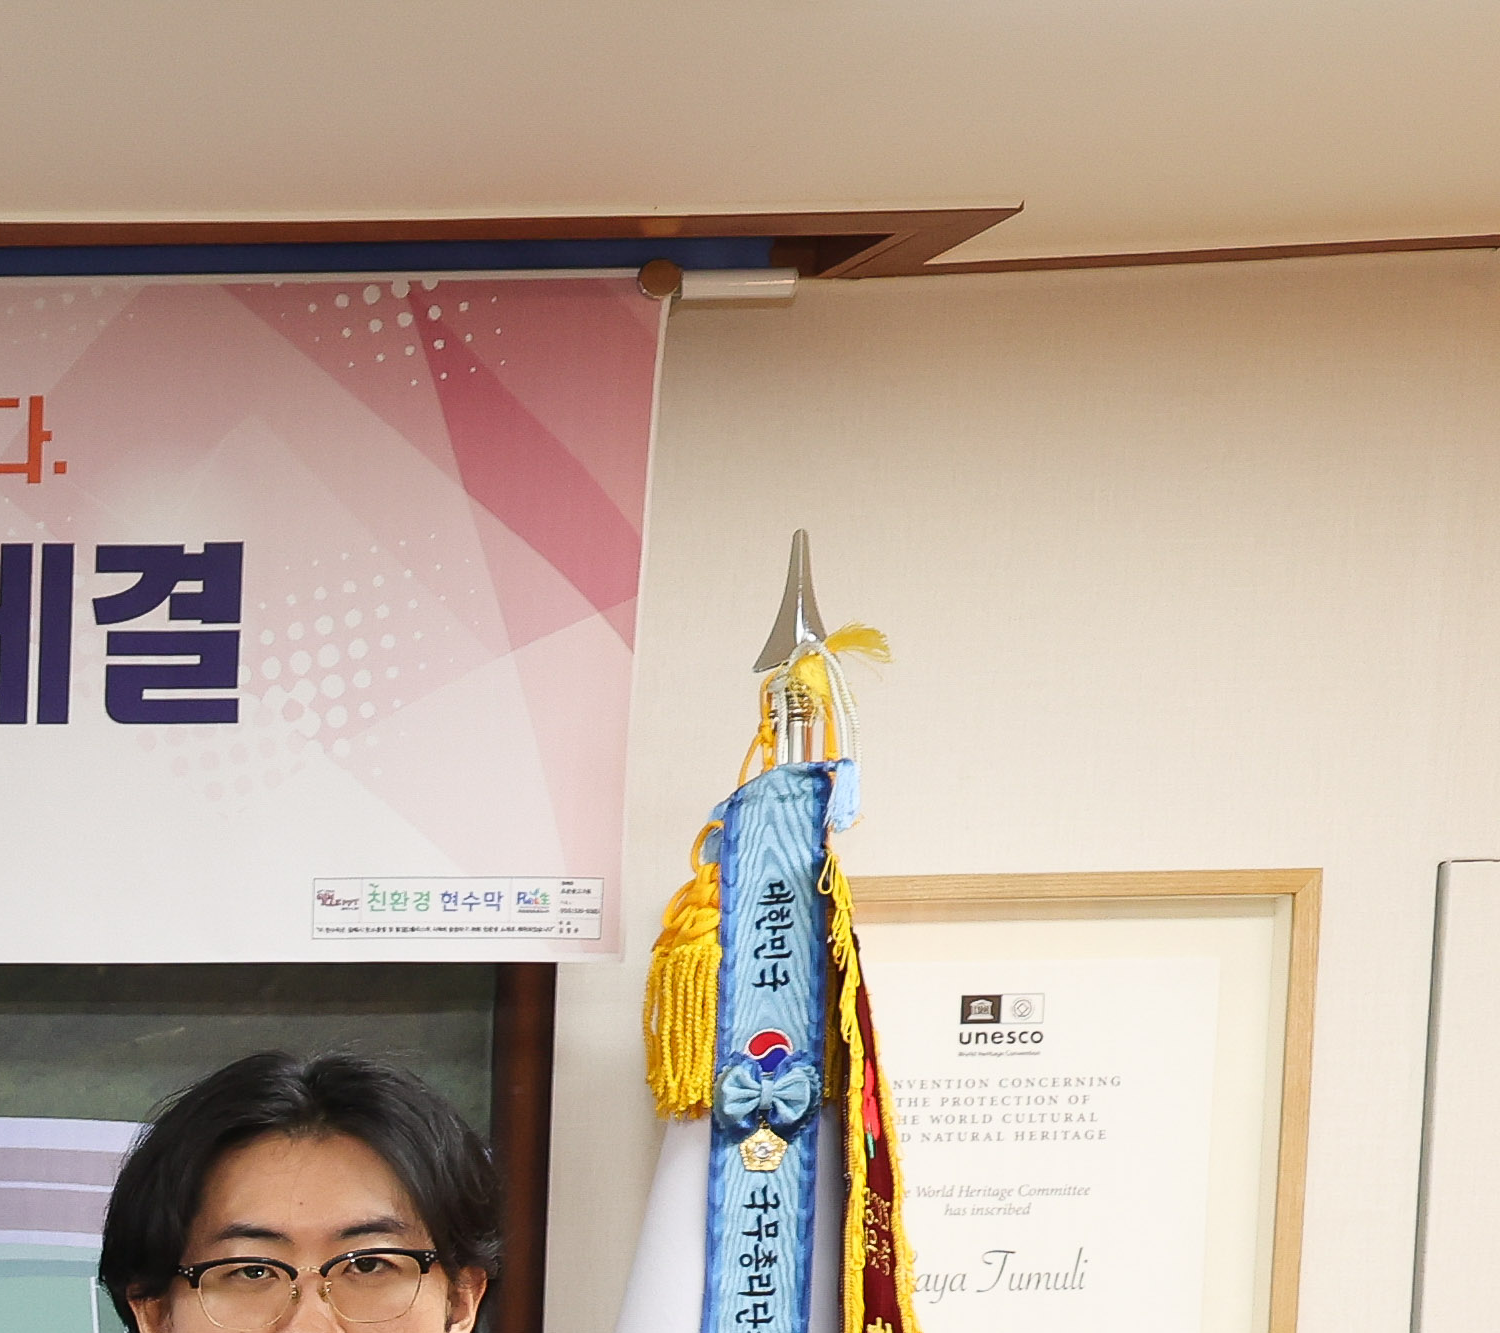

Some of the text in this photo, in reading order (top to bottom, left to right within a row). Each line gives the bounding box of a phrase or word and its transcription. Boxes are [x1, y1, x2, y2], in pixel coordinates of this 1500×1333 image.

[367, 886, 431, 912] 친환경
[440, 890, 503, 912] 현수막
[752, 879, 796, 993] 대한민국
[959, 1029, 1044, 1046] unesco
[893, 1076, 1122, 1090] NVENTION CONCERNING
[896, 1095, 1092, 1107] THE PROTECTION OF
[897, 1113, 1099, 1125] HE WORLD CULTURAL
[921, 1131, 1006, 1143] NATURAL
[1014, 1129, 1108, 1142] HERITAGE
[916, 1186, 955, 1199] World
[958, 1185, 1014, 1201] Heritage
[1017, 1184, 1092, 1198] Committee
[943, 1202, 1032, 1217] has inscribed
[910, 1247, 1088, 1304] aya Tumuli
